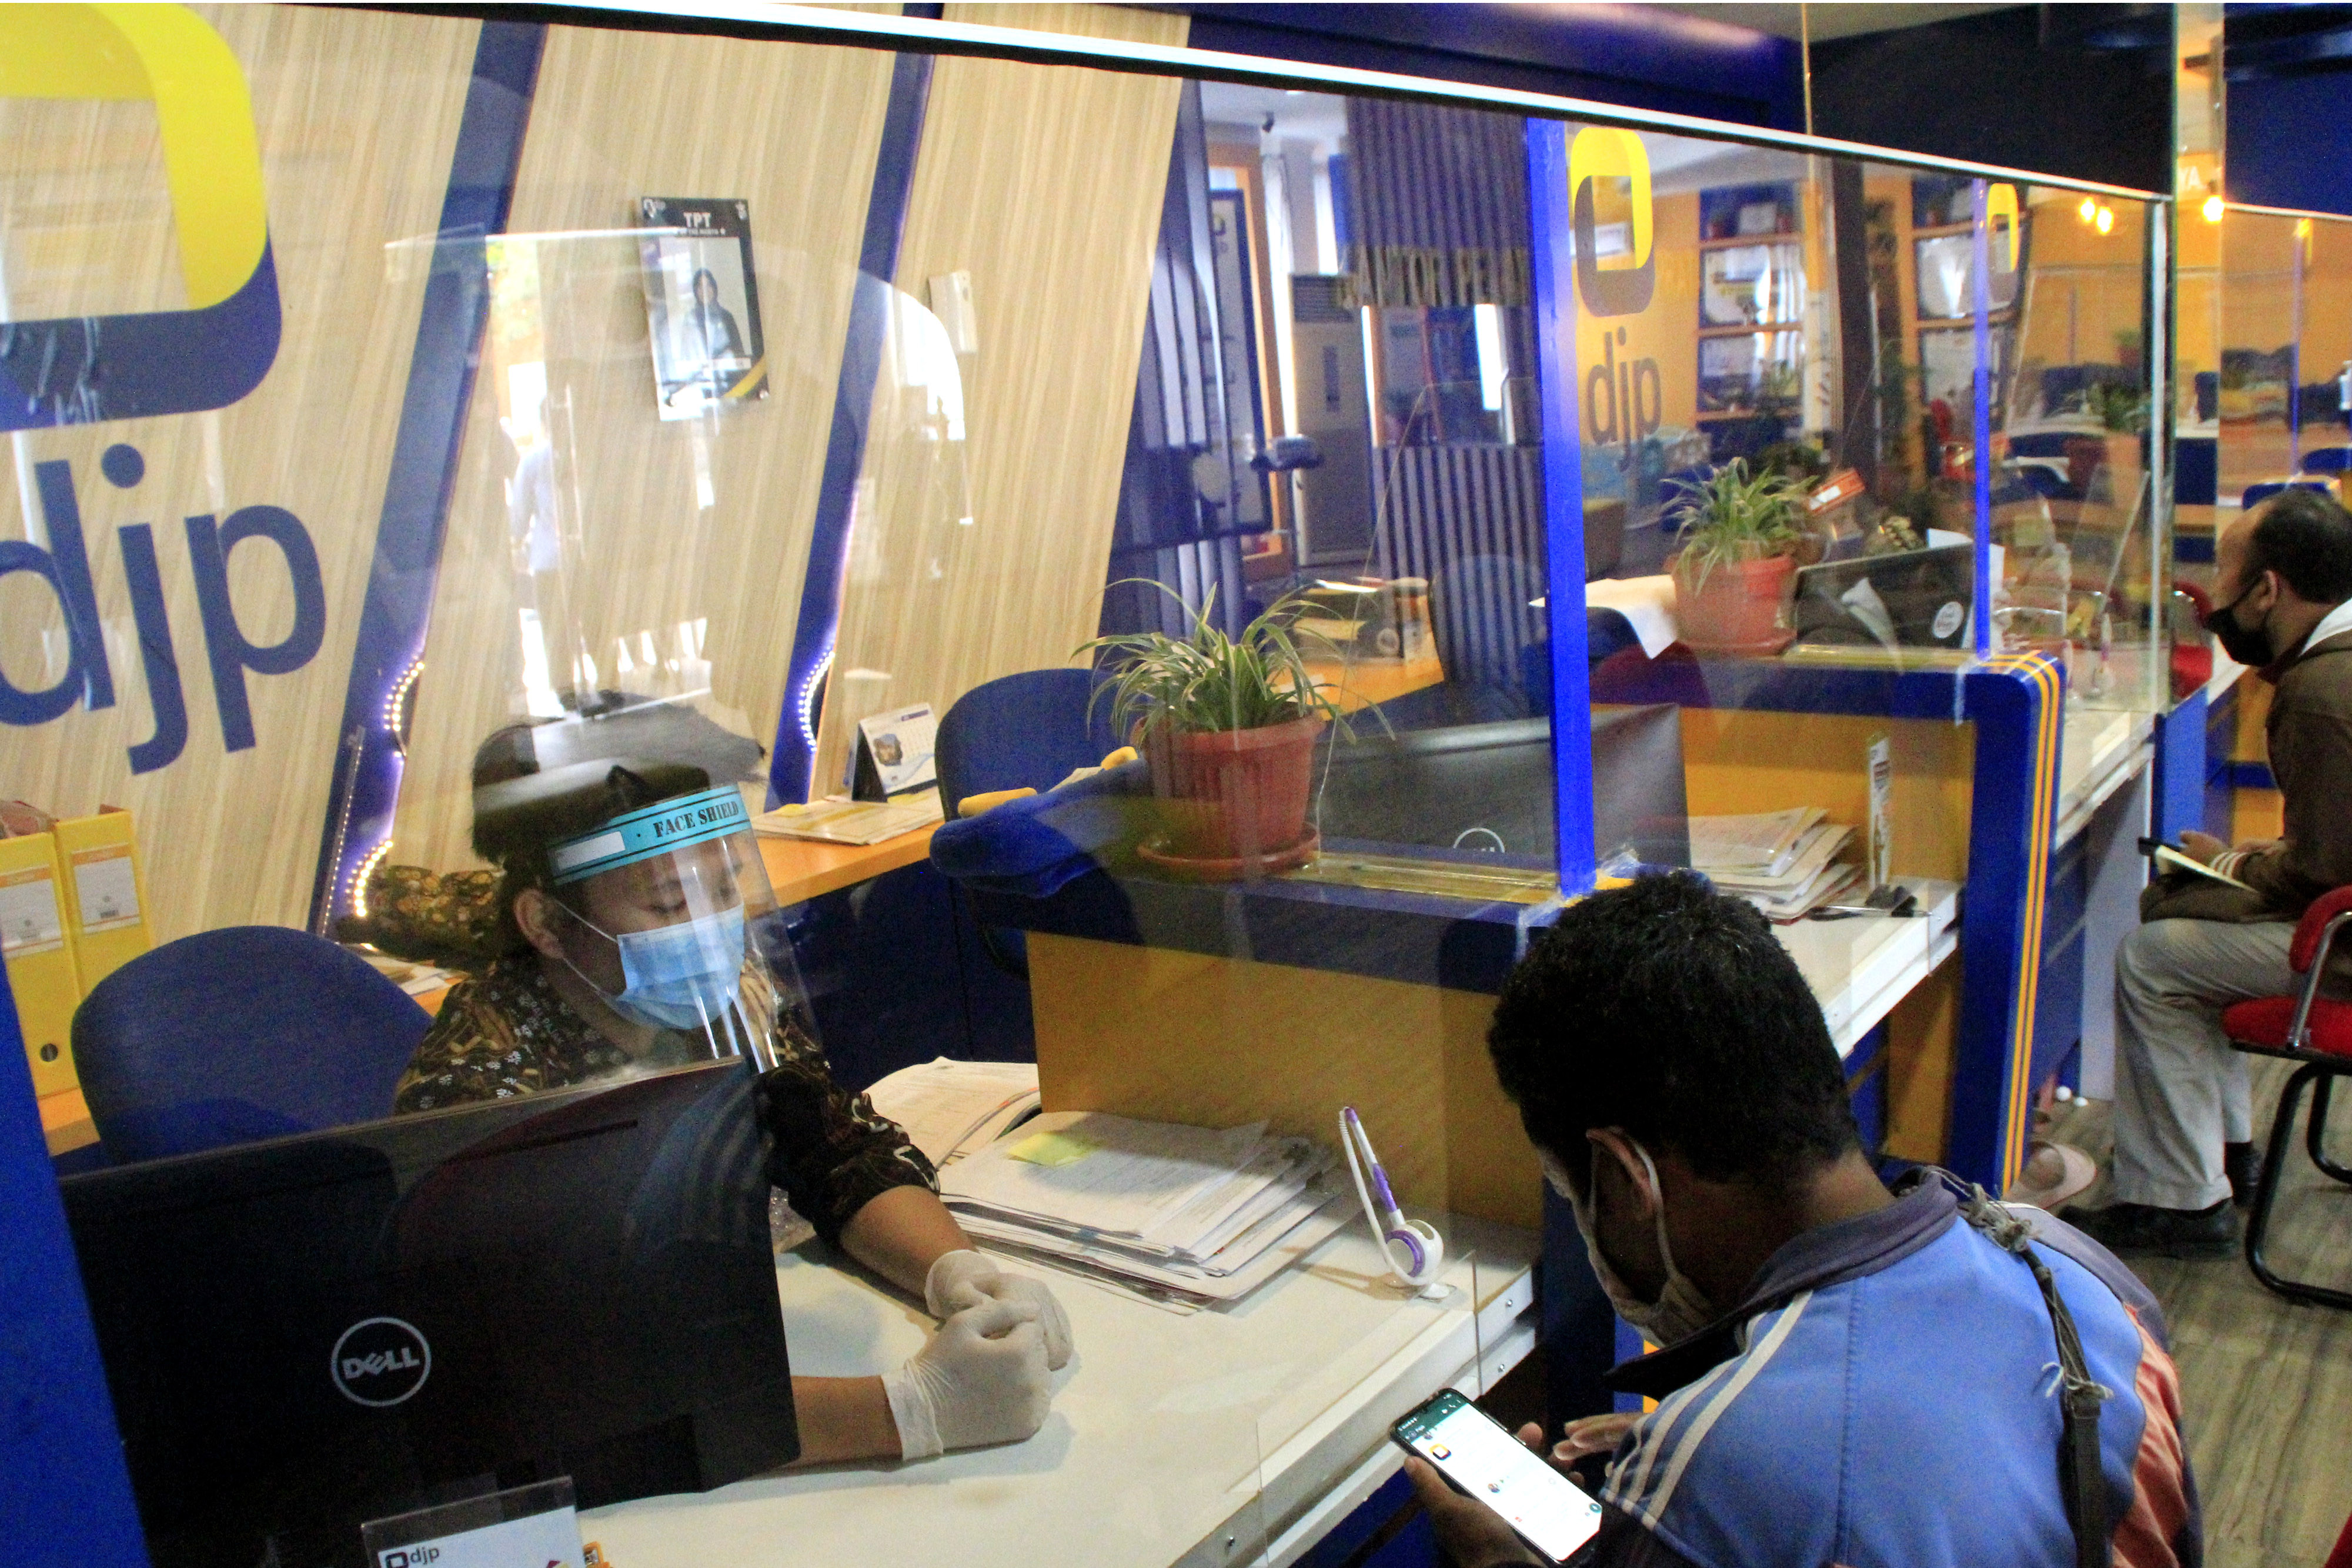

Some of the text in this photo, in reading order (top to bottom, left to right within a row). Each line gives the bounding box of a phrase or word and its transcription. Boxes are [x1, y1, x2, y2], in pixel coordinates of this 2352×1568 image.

[683, 212, 711, 228] TPT
[1586, 326, 1662, 472] djp
[0, 443, 326, 775] djp
[653, 800, 739, 838] FACE SHIELD
[342, 1346, 420, 1380] DELL
[410, 1546, 440, 1566] djp
